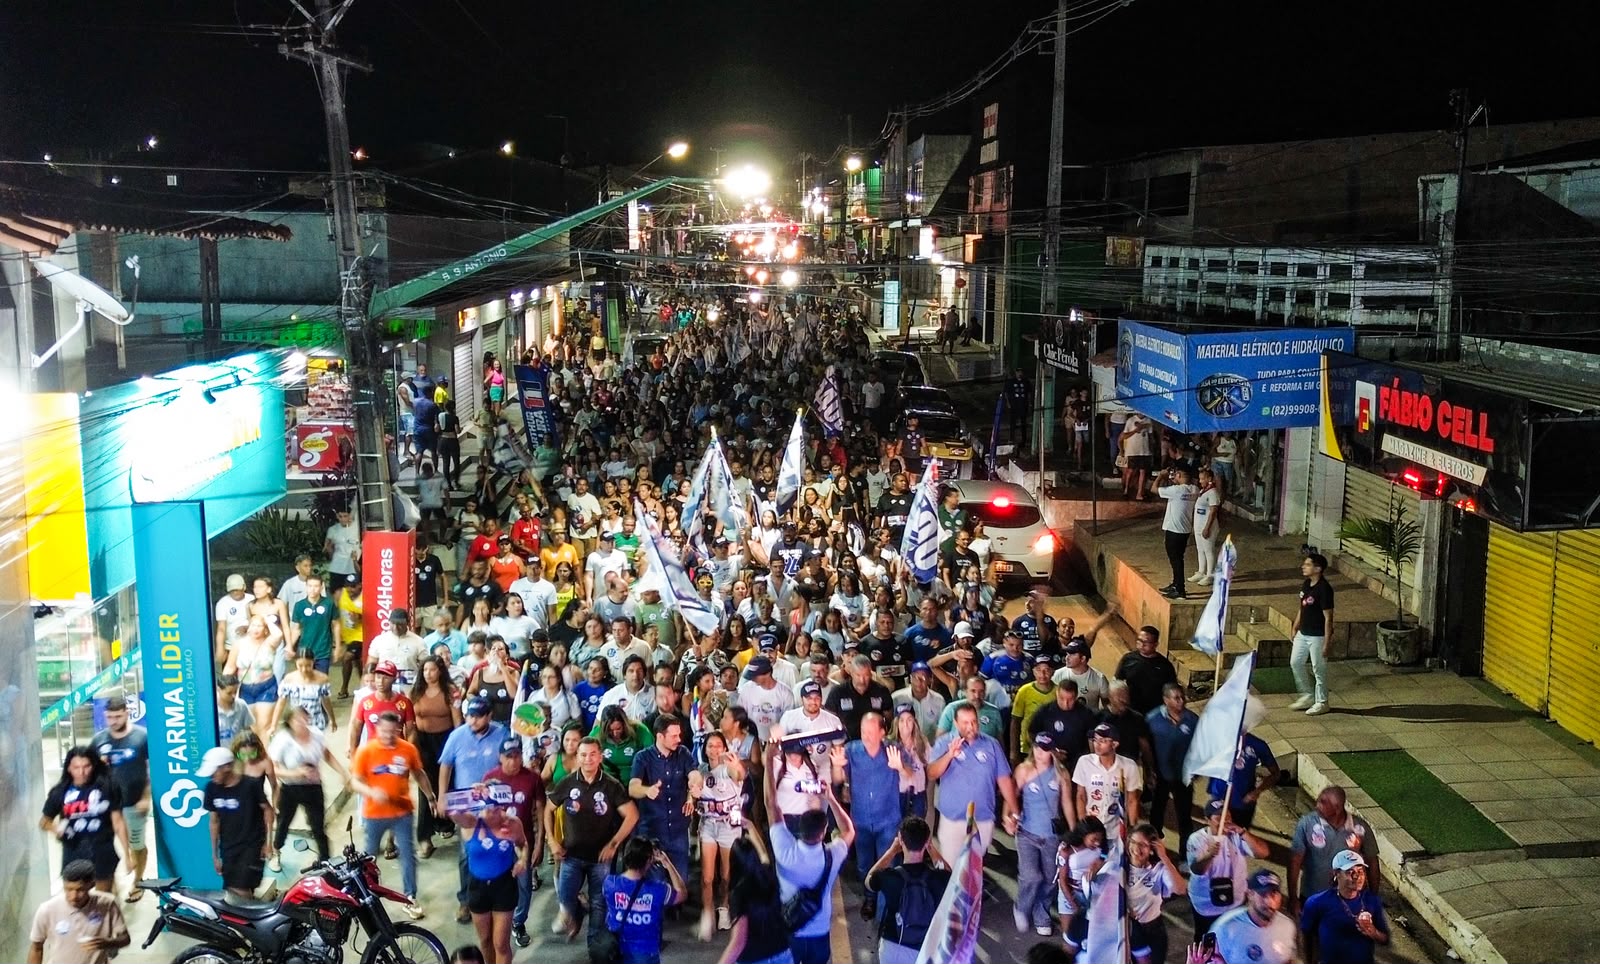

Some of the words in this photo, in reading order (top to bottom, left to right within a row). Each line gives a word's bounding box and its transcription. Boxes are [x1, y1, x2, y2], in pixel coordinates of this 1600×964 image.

[1057, 347, 1079, 368] Pérola
[1197, 344, 1239, 359] MATERIAL
[1242, 338, 1282, 357] ELÉTRICO
[1284, 343, 1290, 355] E
[1291, 335, 1344, 355] HIDRÁULICO
[1262, 383, 1267, 393] E
[1270, 382, 1302, 393] REFORMA
[1304, 381, 1314, 391] EM
[1379, 377, 1433, 432] FÁBIO
[1437, 400, 1494, 453] CELL
[1389, 437, 1428, 463] MAGAZINE
[1438, 457, 1475, 481] ELETROS
[186, 648, 194, 680] BAIXO
